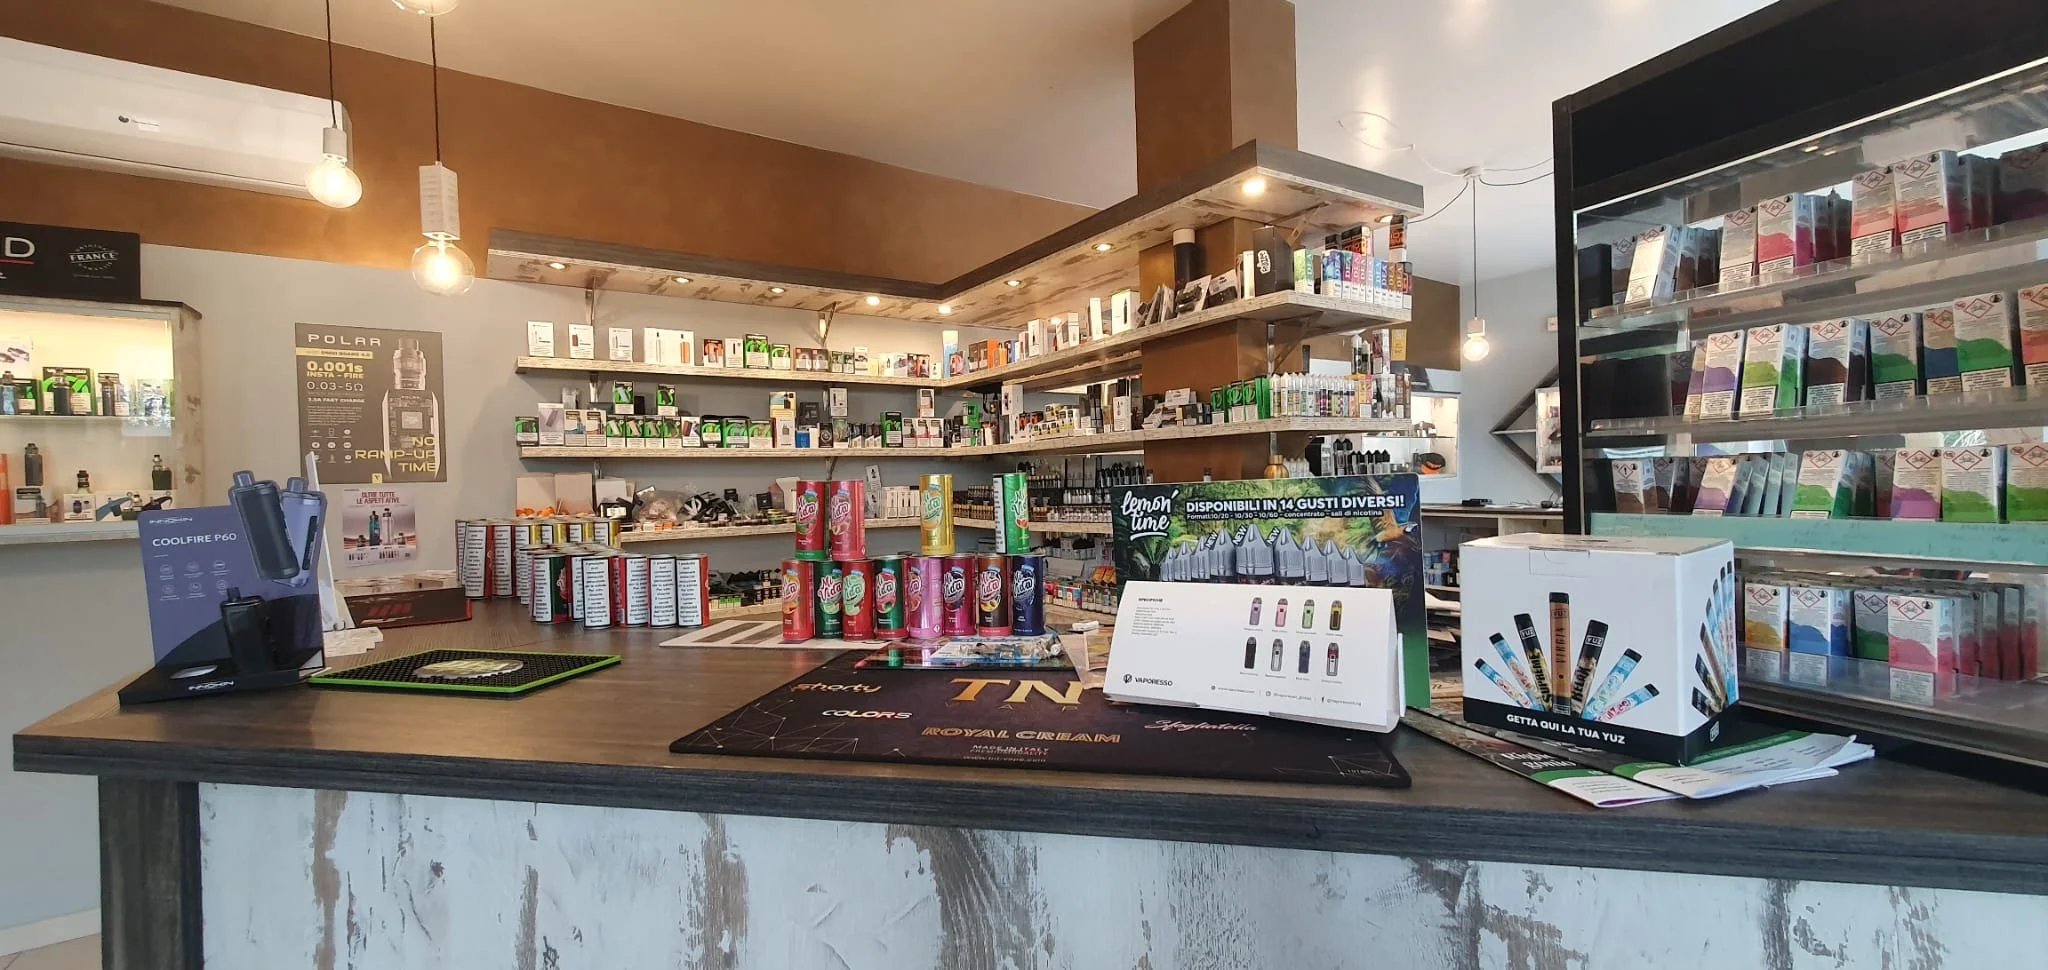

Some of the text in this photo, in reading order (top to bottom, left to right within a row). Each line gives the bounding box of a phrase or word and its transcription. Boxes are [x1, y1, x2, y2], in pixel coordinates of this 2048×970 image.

[69, 252, 116, 261] FRANCE
[308, 334, 381, 347] POLAR
[306, 360, 363, 373] 0.001s
[412, 437, 435, 446] NO
[355, 449, 436, 459] RAMP-UP
[398, 463, 437, 472] TIME
[1186, 495, 1404, 512] DISPONIBILI IN 14 GUSTI DIVERSI!
[1130, 511, 1170, 531] time
[152, 532, 237, 547] COOLFIRE P60
[1205, 531, 1218, 549] NEW
[1232, 525, 1248, 545] NEW
[1266, 527, 1281, 545] NEW
[822, 575, 833, 587] Mi
[819, 581, 842, 602] Vida
[1555, 627, 1566, 664] VIRGIN
[1586, 636, 1604, 646] YUZ
[1134, 676, 1174, 687] VAPORESSO
[1528, 651, 1552, 703] SUPREME
[791, 682, 882, 693] shorty
[950, 678, 1086, 705] TN
[822, 709, 912, 719] COLORS
[920, 727, 1121, 743] ROYAL CREAM
[1506, 714, 1625, 744] GETTA QUI LA TUA YUZ
